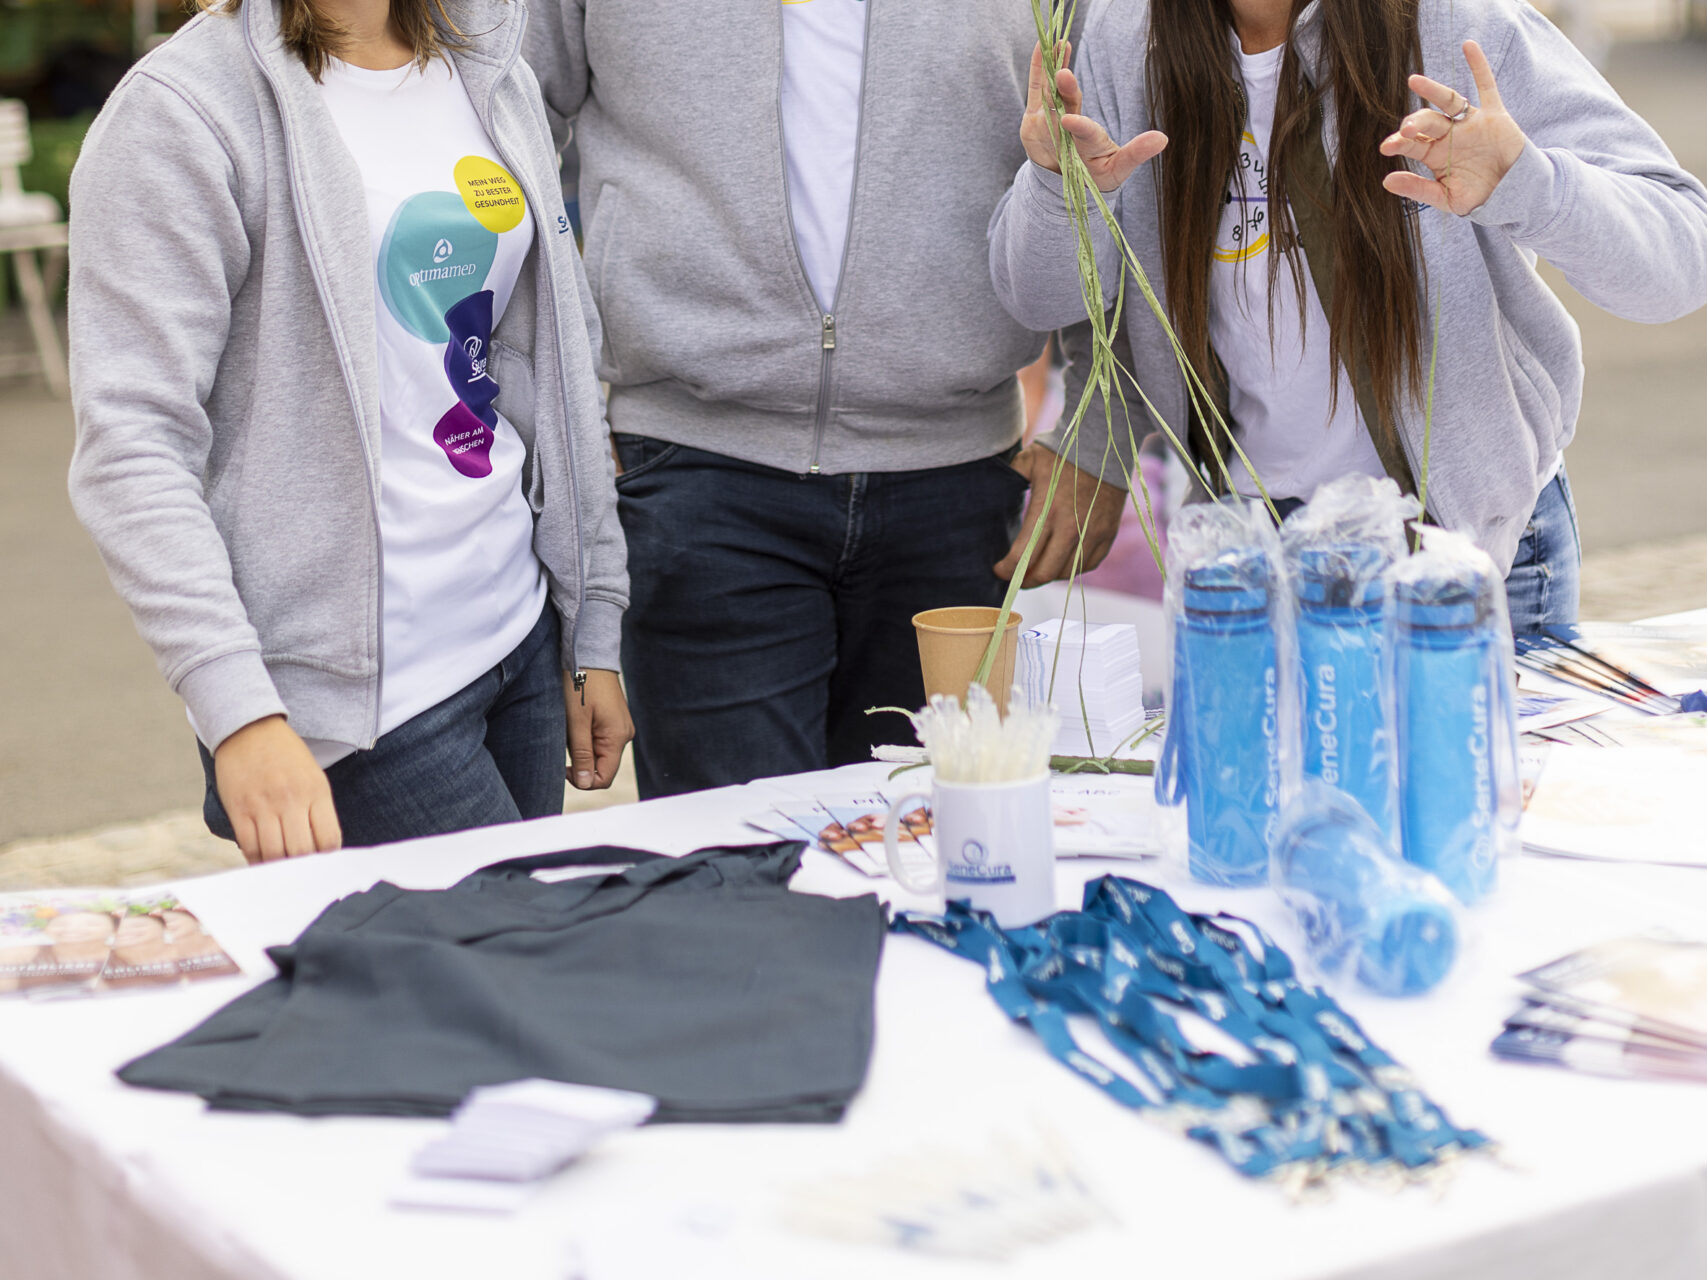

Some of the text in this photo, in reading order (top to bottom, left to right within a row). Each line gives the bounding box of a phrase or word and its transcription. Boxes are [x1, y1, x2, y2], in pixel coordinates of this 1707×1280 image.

[1240, 152, 1251, 169] 3
[1253, 159, 1264, 178] 4
[467, 176, 507, 187] MEIN WEG
[474, 186, 512, 197] ZU BESTER
[474, 197, 520, 209] GESUNDHEIT
[1231, 224, 1242, 242] 8
[444, 425, 485, 447] NÄHER AM
[1315, 663, 1339, 786] eneCura
